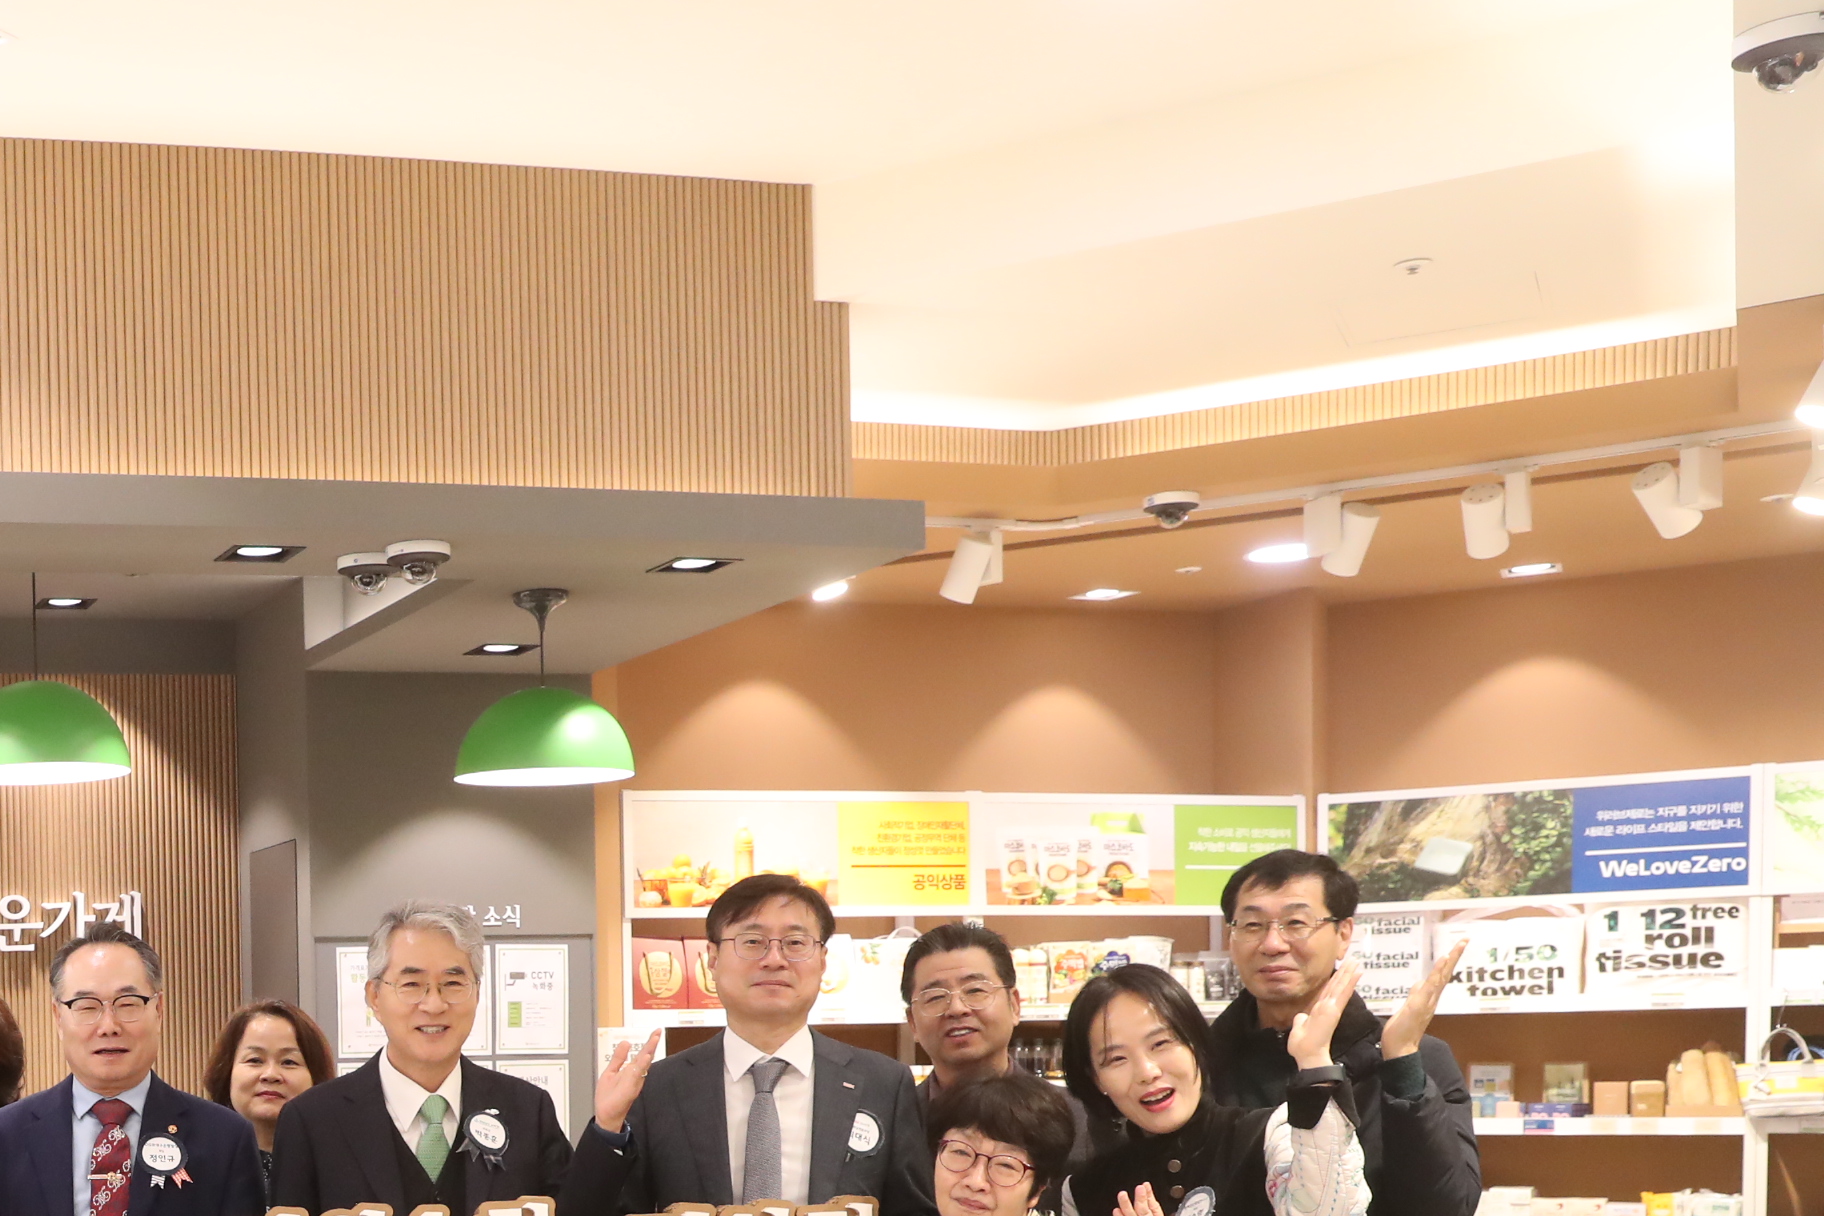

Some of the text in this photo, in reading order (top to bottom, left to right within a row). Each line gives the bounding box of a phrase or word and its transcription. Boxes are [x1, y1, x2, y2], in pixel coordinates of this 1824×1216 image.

[1657, 805, 1688, 817] 지구를
[1689, 802, 1721, 815] 지키기
[1722, 801, 1745, 814] 위한
[1584, 825, 1614, 837] 새로운
[1615, 823, 1648, 836] 라이프
[1599, 855, 1747, 878] WeLoveZero
[912, 874, 967, 891] 공익상품
[482, 904, 522, 928] 소식
[1377, 916, 1421, 927] facial
[1644, 926, 1715, 950] roll
[1376, 951, 1419, 961] facial
[1596, 949, 1725, 973] tissue
[1363, 960, 1410, 969] tissue
[531, 971, 555, 980] CCTV
[1375, 985, 1412, 995] facia
[1467, 979, 1555, 997] towel
[149, 1154, 175, 1163] 정인규
